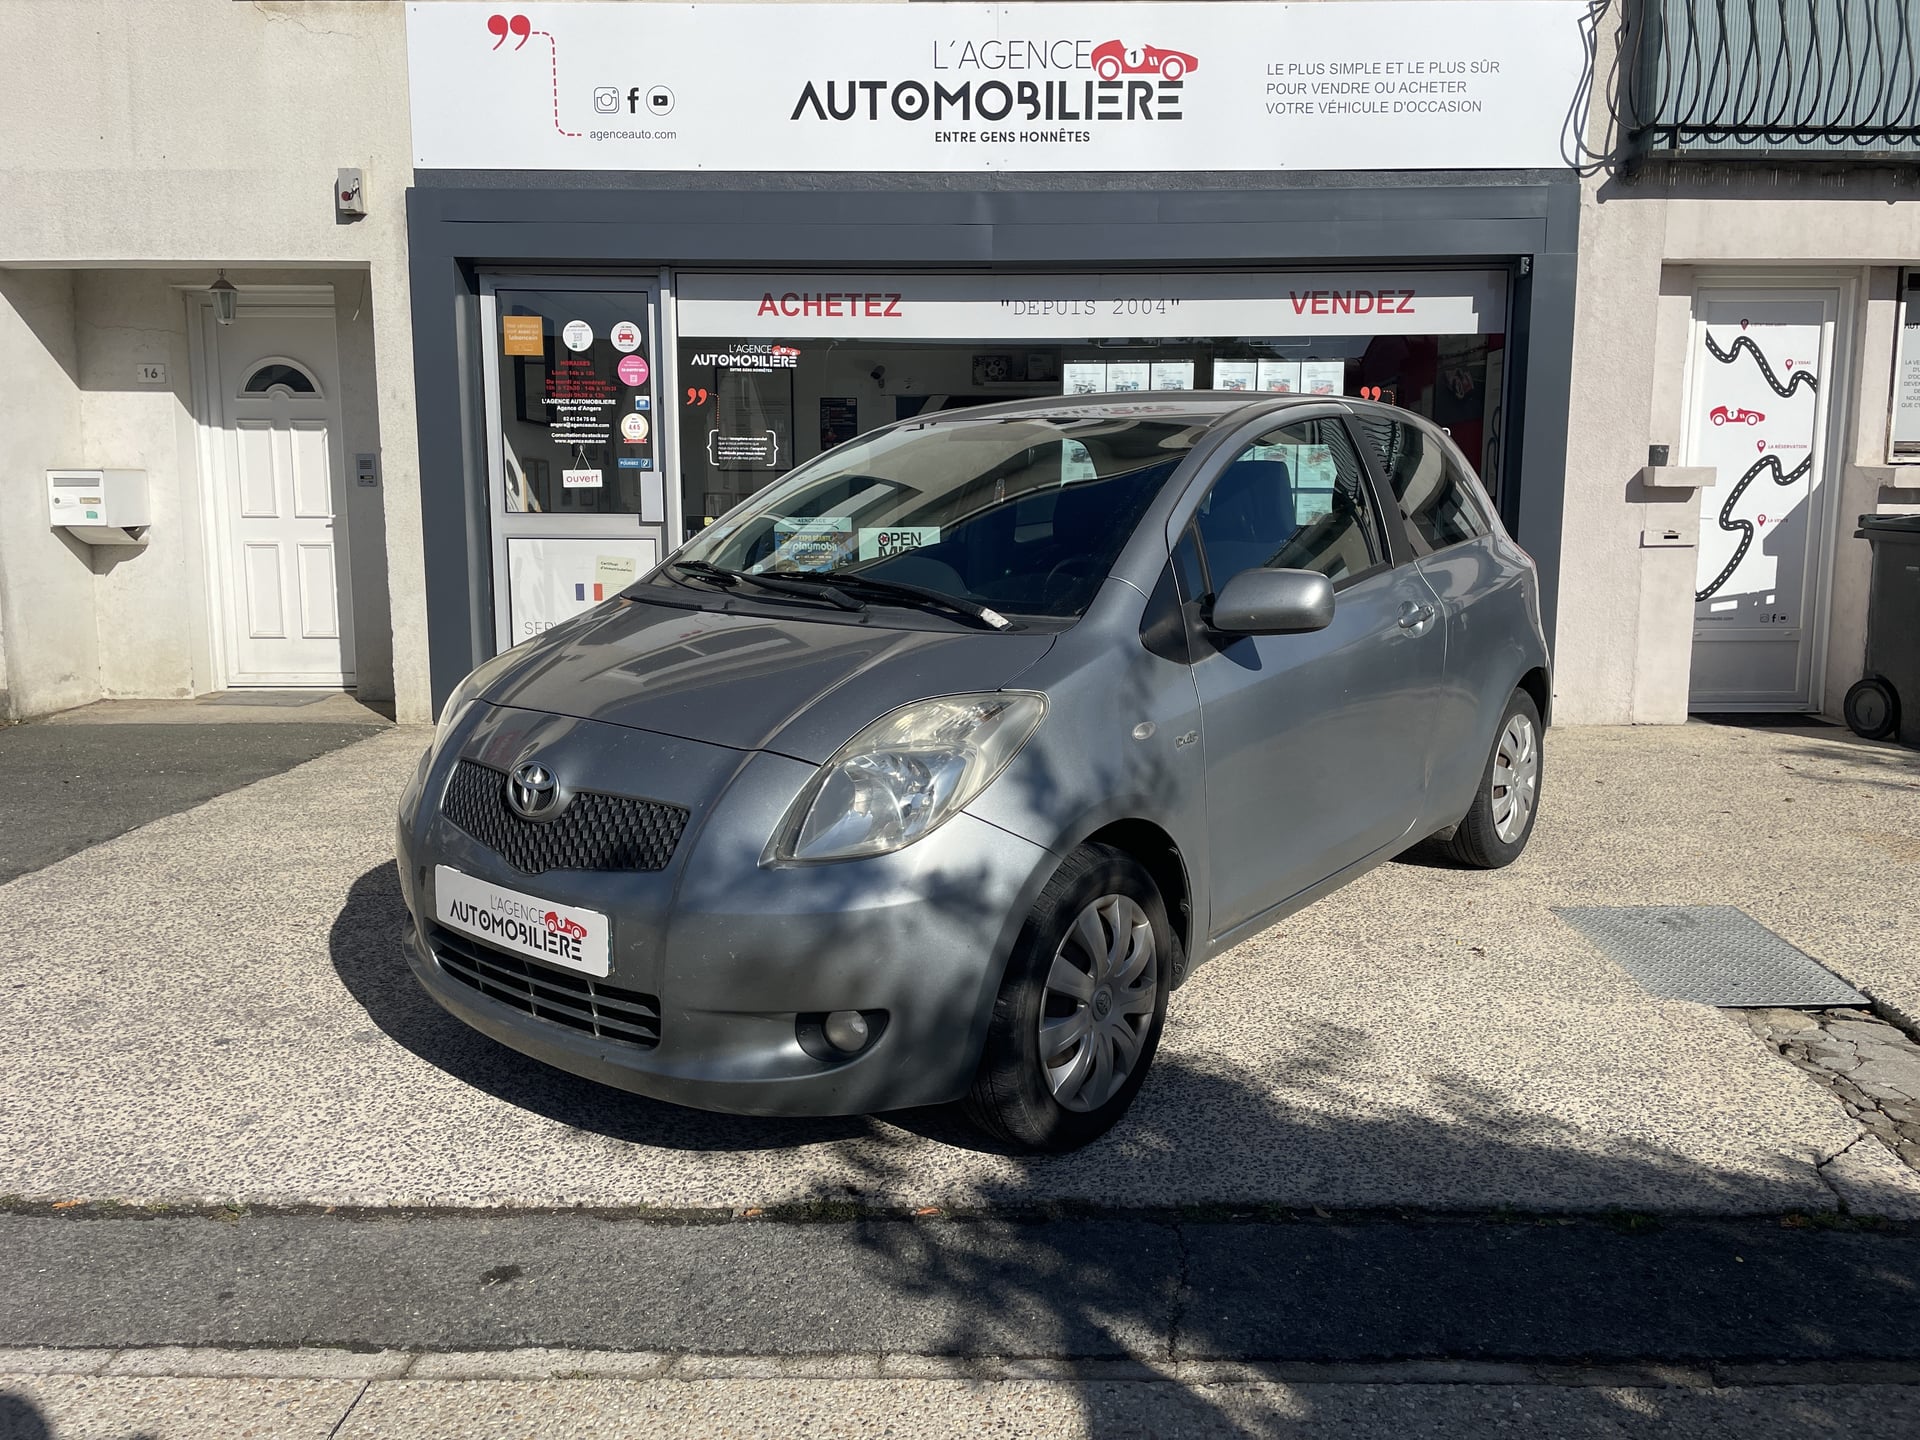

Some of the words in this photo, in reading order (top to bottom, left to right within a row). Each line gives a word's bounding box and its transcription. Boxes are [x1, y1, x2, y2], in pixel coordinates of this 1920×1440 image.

[933, 39, 1092, 70] L'AGENCE
[1267, 63, 1284, 76] LE
[1288, 62, 1325, 75] PLUS
[1329, 62, 1381, 75] SIMPLE
[1385, 62, 1404, 74] ET
[1407, 62, 1425, 74] LE
[1429, 61, 1466, 74] PLUS
[1470, 59, 1500, 73] SÛR
[1266, 82, 1307, 95] POUR
[1311, 82, 1370, 94] VENDRE
[1374, 82, 1396, 94] OU
[1398, 81, 1467, 94] ACHETER
[1265, 102, 1314, 115] VOTRE
[1318, 99, 1389, 114] VÉHICULE
[1393, 100, 1482, 113] D'OCCASION
[589, 128, 677, 142] agenceauto.com
[935, 130, 977, 143] ENTRE
[980, 130, 1016, 143] GENS
[1019, 127, 1091, 143] HONNÊTES
[757, 292, 903, 318] ACHETEZ
[1289, 289, 1415, 315] VENDEZ
[728, 344, 772, 354] L'AGENCE
[143, 367, 158, 379] 16
[566, 474, 599, 484] ouvert
[877, 531, 922, 547] OPEN
[490, 894, 545, 926] L'AGENCE
